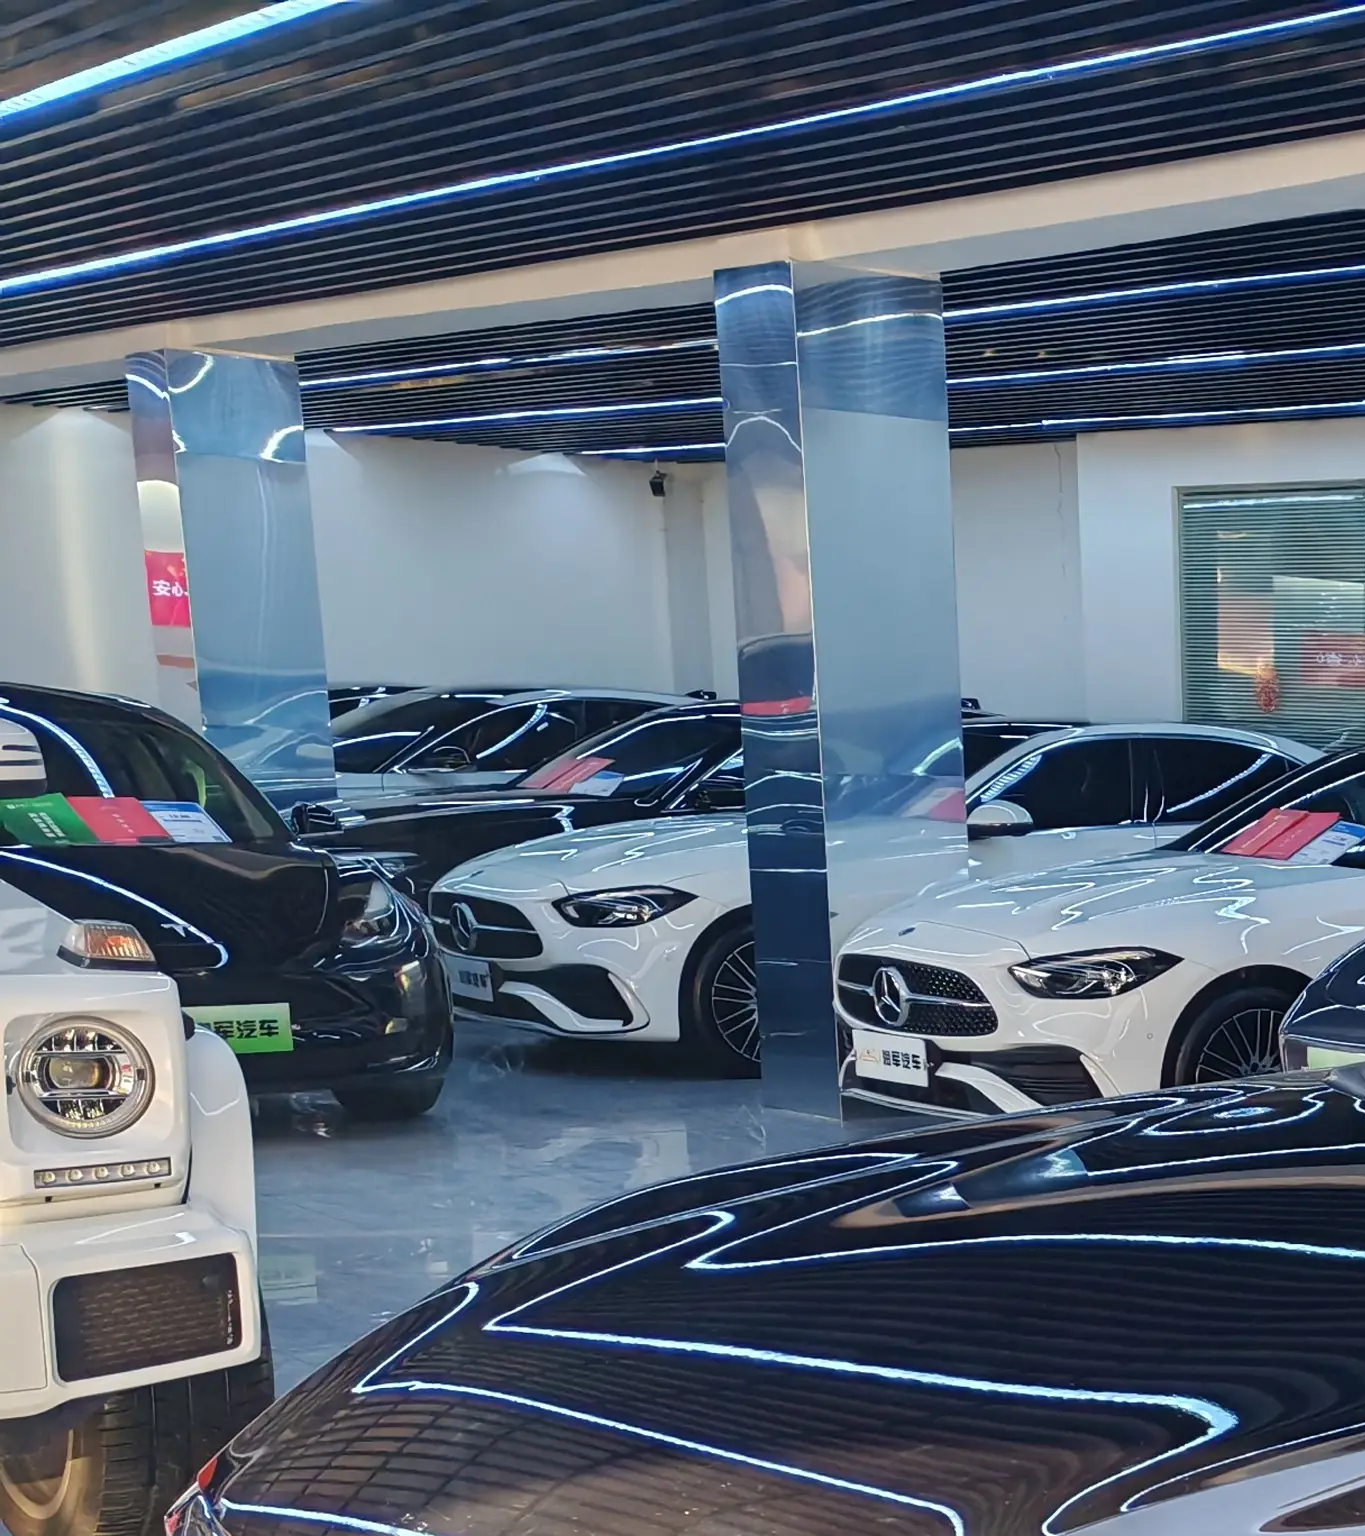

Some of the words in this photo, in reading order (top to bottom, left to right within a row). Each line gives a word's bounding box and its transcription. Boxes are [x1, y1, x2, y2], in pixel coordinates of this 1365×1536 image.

[152, 579, 188, 597] 安心
[195, 1018, 280, 1040] 军汽车
